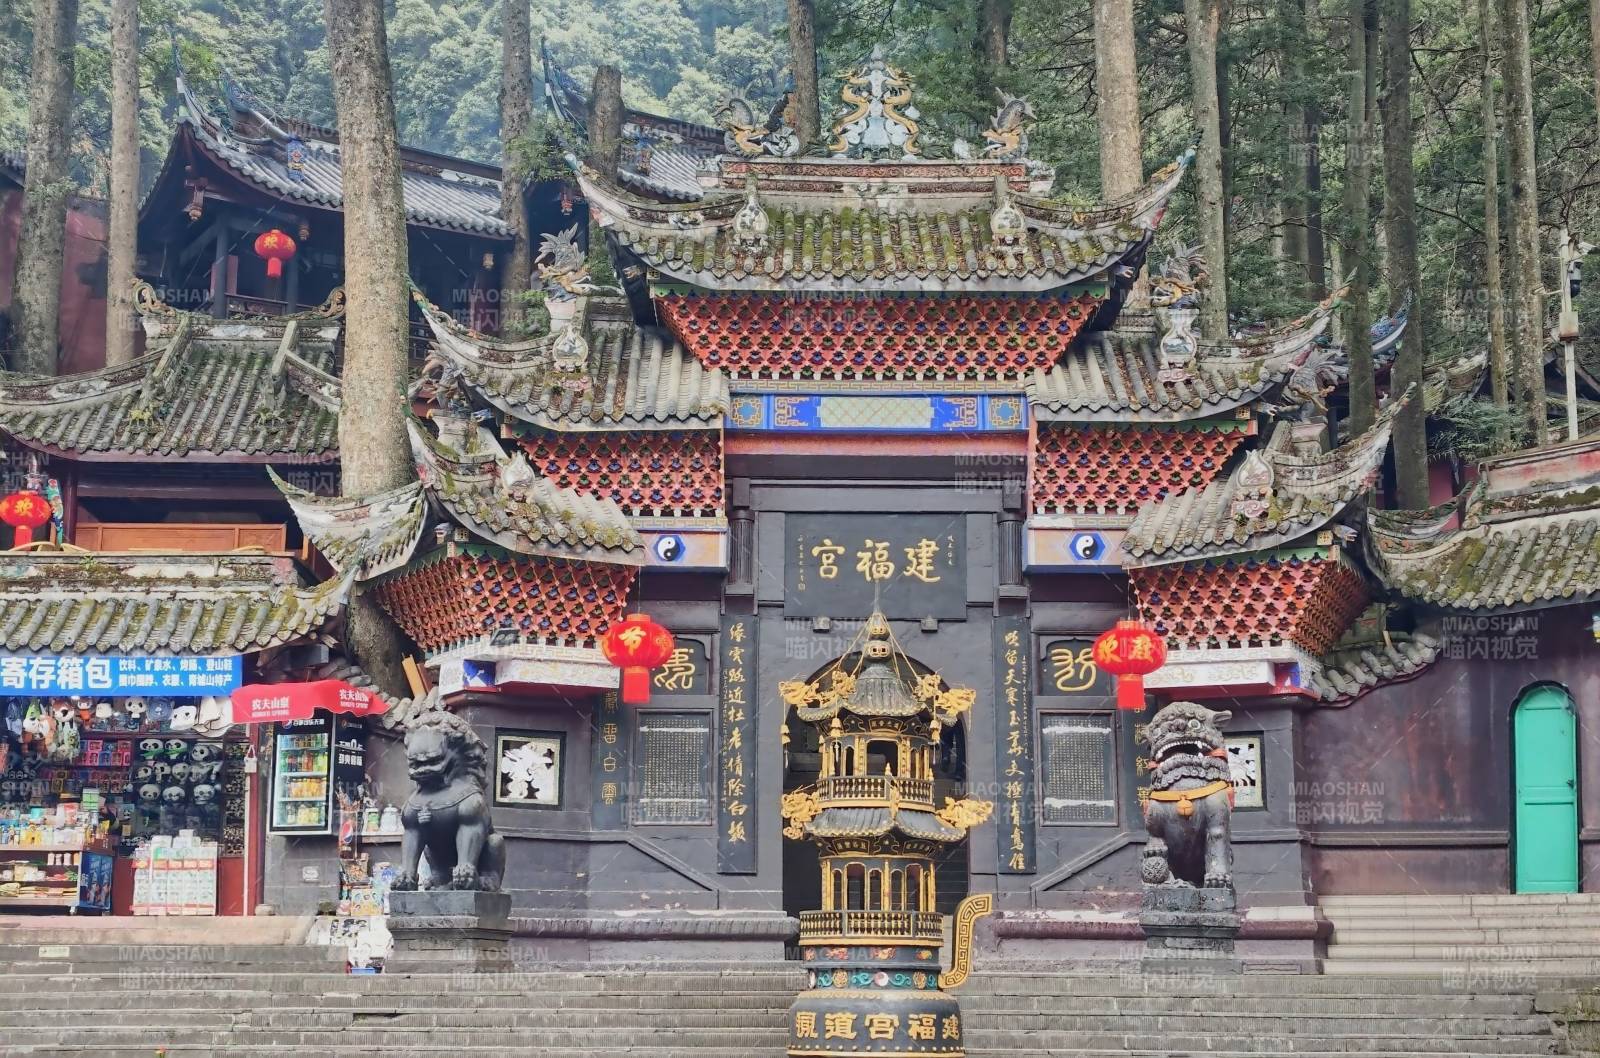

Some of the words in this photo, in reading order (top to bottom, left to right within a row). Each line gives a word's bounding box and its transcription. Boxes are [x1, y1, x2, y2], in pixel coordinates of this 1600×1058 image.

[0, 657, 113, 689] 寄存箱包
[252, 696, 290, 711] 农夫山泉
